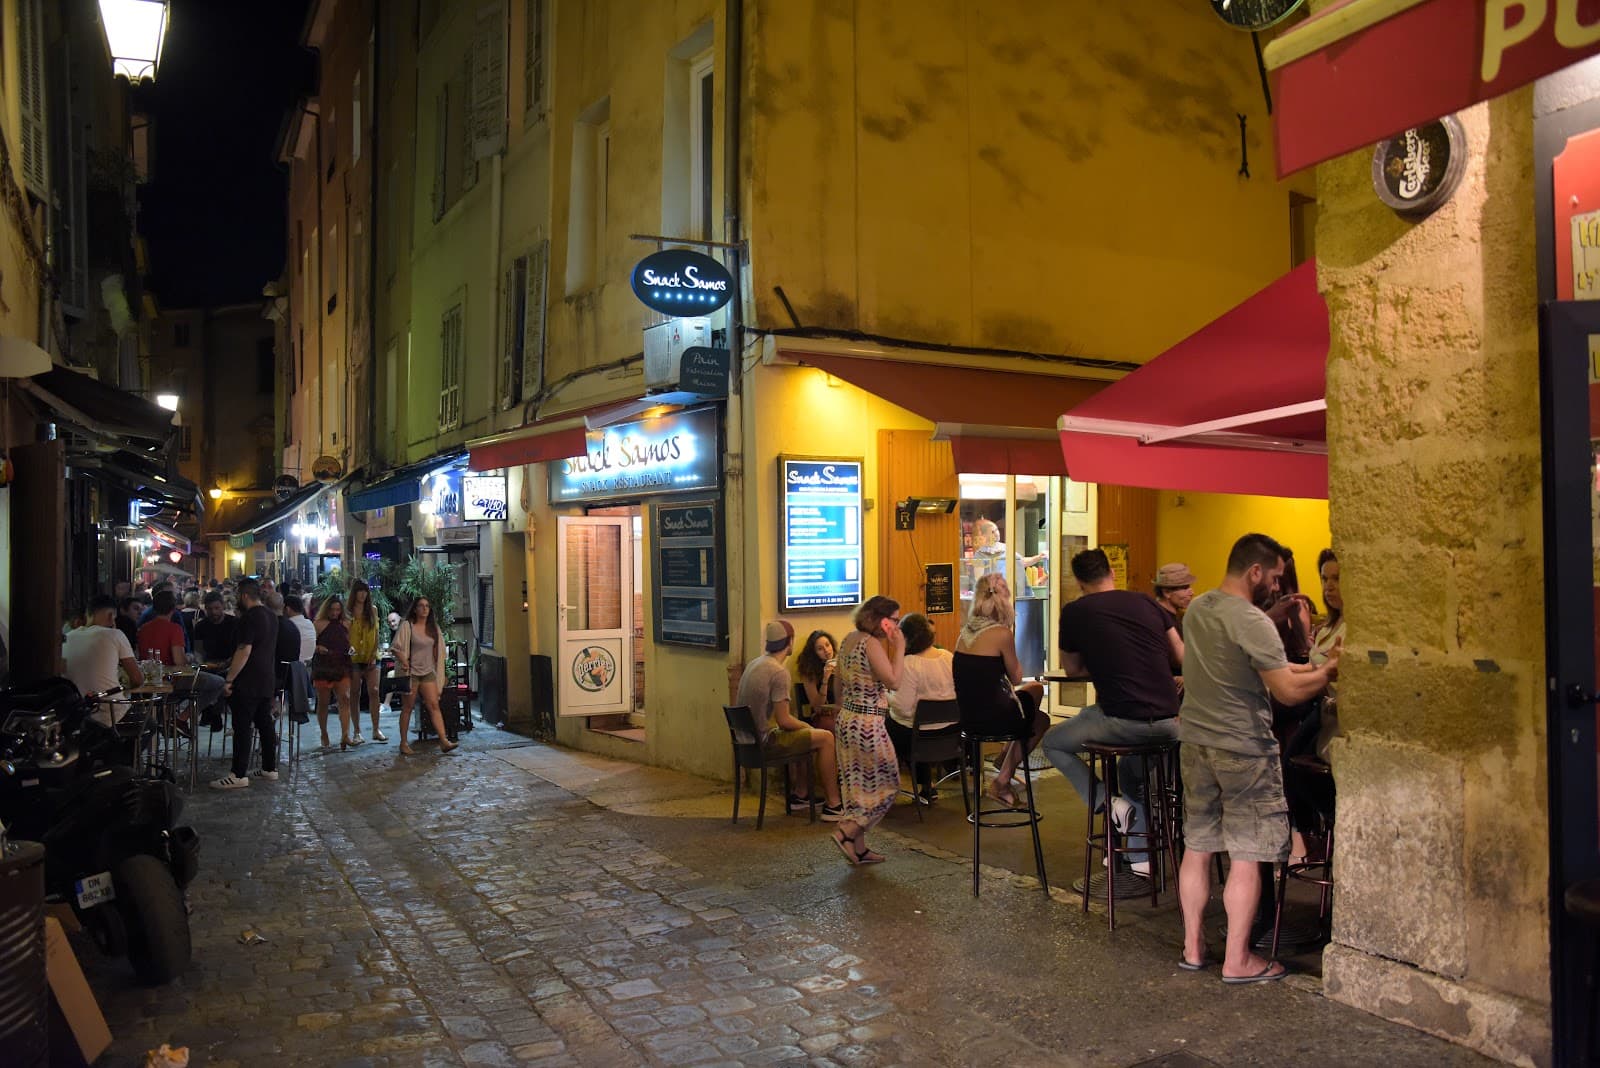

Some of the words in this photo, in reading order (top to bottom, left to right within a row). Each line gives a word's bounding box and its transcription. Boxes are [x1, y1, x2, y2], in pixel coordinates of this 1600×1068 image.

[643, 269, 681, 288] Snack
[682, 266, 726, 290] Samos
[618, 436, 680, 467] Samos
[582, 480, 608, 493] SNACK
[614, 471, 672, 490] RESTAURANT
